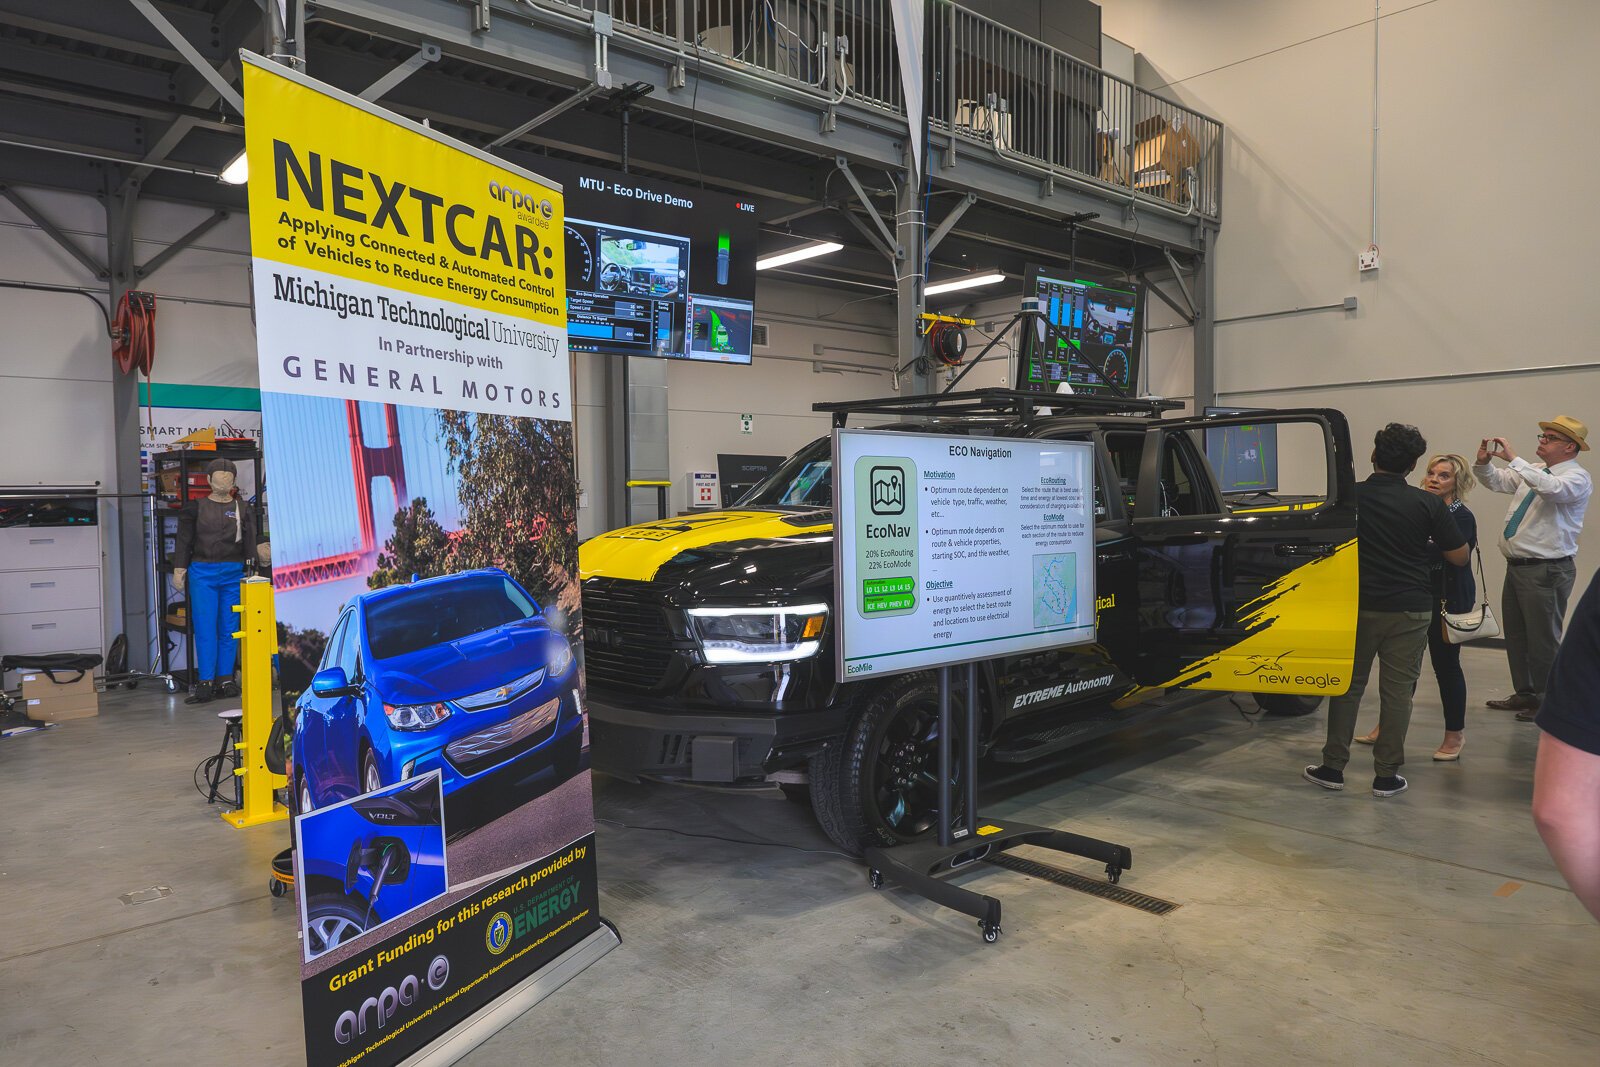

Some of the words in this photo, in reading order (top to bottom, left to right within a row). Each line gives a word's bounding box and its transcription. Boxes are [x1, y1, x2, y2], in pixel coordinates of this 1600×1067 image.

[579, 177, 605, 192] MTU
[613, 184, 633, 197] Eco
[635, 188, 663, 203] Drive
[664, 194, 693, 209] Demo
[273, 138, 554, 280] NEXTCAR:
[740, 203, 755, 213] LIVE
[517, 211, 549, 230] awardee
[278, 211, 355, 247] Applying
[360, 234, 435, 266] Connected
[439, 256, 449, 269] &
[452, 260, 516, 287] Automated
[518, 279, 555, 298] Control
[277, 236, 296, 250] of
[304, 240, 371, 269] Vehicles
[375, 259, 389, 274] to
[393, 263, 444, 287] Reduce
[447, 277, 488, 301] Energy
[490, 290, 559, 316] Consumption
[272, 273, 374, 319] Michigan
[377, 296, 490, 340] Technological
[491, 321, 559, 358] University
[378, 336, 393, 352] In
[396, 342, 474, 368] Partnership
[477, 355, 503, 370] with
[283, 355, 443, 395] GENERAL
[461, 379, 560, 409] MOTORS
[139, 426, 182, 436] SMART
[949, 445, 968, 457] ECO
[970, 447, 1012, 460] Navigation
[923, 470, 955, 480] Motivation
[1041, 477, 1066, 485] EcoRouting
[931, 486, 957, 494] Optimum
[973, 486, 1001, 495] dependent
[931, 498, 950, 506] vehicle
[967, 497, 984, 506] traffic,
[985, 497, 1008, 505] weather,
[1043, 513, 1064, 521] EcoMode
[866, 523, 911, 539] EcoNav
[931, 528, 957, 536] Optimum
[974, 526, 997, 535] depends
[947, 539, 953, 547] &
[953, 538, 973, 547] vehicle
[865, 549, 880, 558] 20%
[880, 548, 914, 558] EcoRouting
[931, 551, 953, 560] starting
[953, 550, 967, 559] SOC,
[988, 548, 1010, 557] weather,
[868, 561, 882, 570] 22%
[883, 559, 912, 569] EcoMode
[926, 580, 954, 589] Objective
[944, 591, 976, 603] quantitively
[976, 589, 1006, 598] assessment
[933, 606, 952, 615] energy
[959, 603, 976, 612] select
[976, 602, 986, 610] the
[986, 601, 997, 609] best
[998, 600, 1012, 608] route
[933, 619, 944, 627] and
[944, 617, 969, 626] locations
[986, 611, 1010, 621] electrical
[933, 631, 953, 639] energy
[847, 662, 873, 675] EcoMile
[1258, 674, 1291, 684] new
[1294, 673, 1341, 689] eagle
[1012, 684, 1065, 709] EXTREME
[1064, 674, 1114, 695] Autonomy
[368, 811, 397, 820] VOLT
[527, 881, 566, 907] DEPARTMENT
[513, 880, 581, 940] ENERGY
[328, 958, 374, 992] Grant
[376, 927, 435, 968] Funding
[436, 918, 455, 935] for
[457, 904, 480, 923] this
[481, 876, 528, 910] research
[530, 850, 574, 887] provided
[574, 846, 587, 860] by
[337, 1051, 365, 1067] Michigan
[365, 1020, 405, 1054] Technological
[405, 1007, 433, 1029] University
[438, 1001, 446, 1009] an
[445, 986, 460, 1004] Equal
[459, 971, 489, 994] Opportunity
[489, 954, 515, 975] Educational
